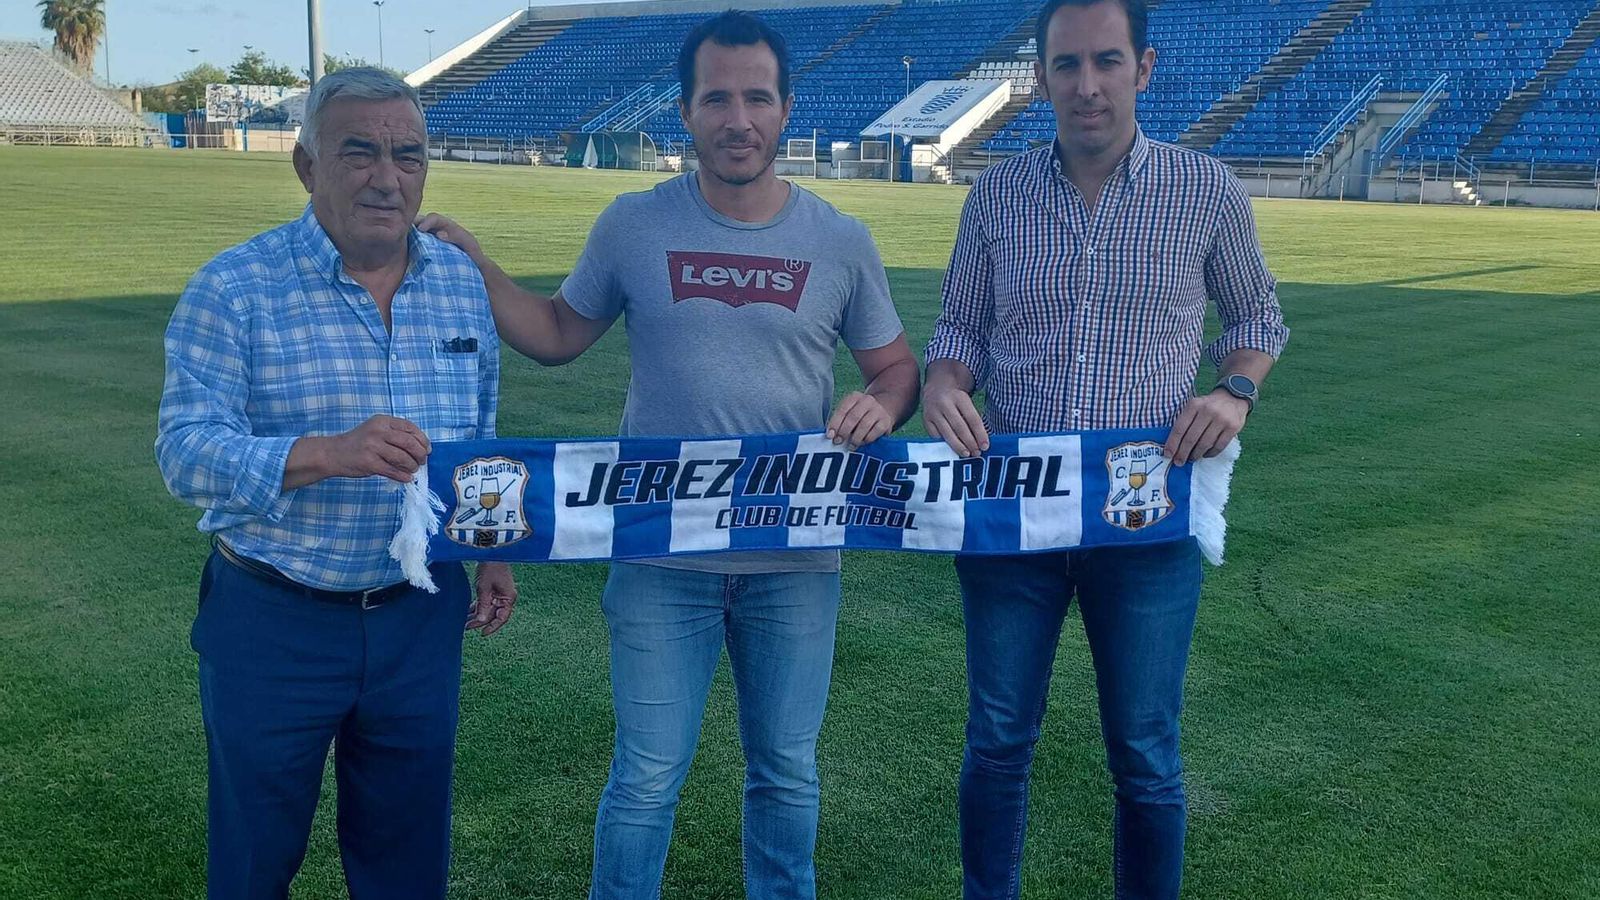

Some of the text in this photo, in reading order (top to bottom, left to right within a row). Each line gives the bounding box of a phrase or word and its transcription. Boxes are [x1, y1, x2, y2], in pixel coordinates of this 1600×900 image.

[1110, 447, 1164, 462] JEREZ INDUSTRI
[458, 463, 523, 481] JEREZ INDUSTRIAL
[564, 451, 1070, 508] JEREZ INDUSTRIAL
[715, 500, 919, 530] CLUB DE FÚTBOL
